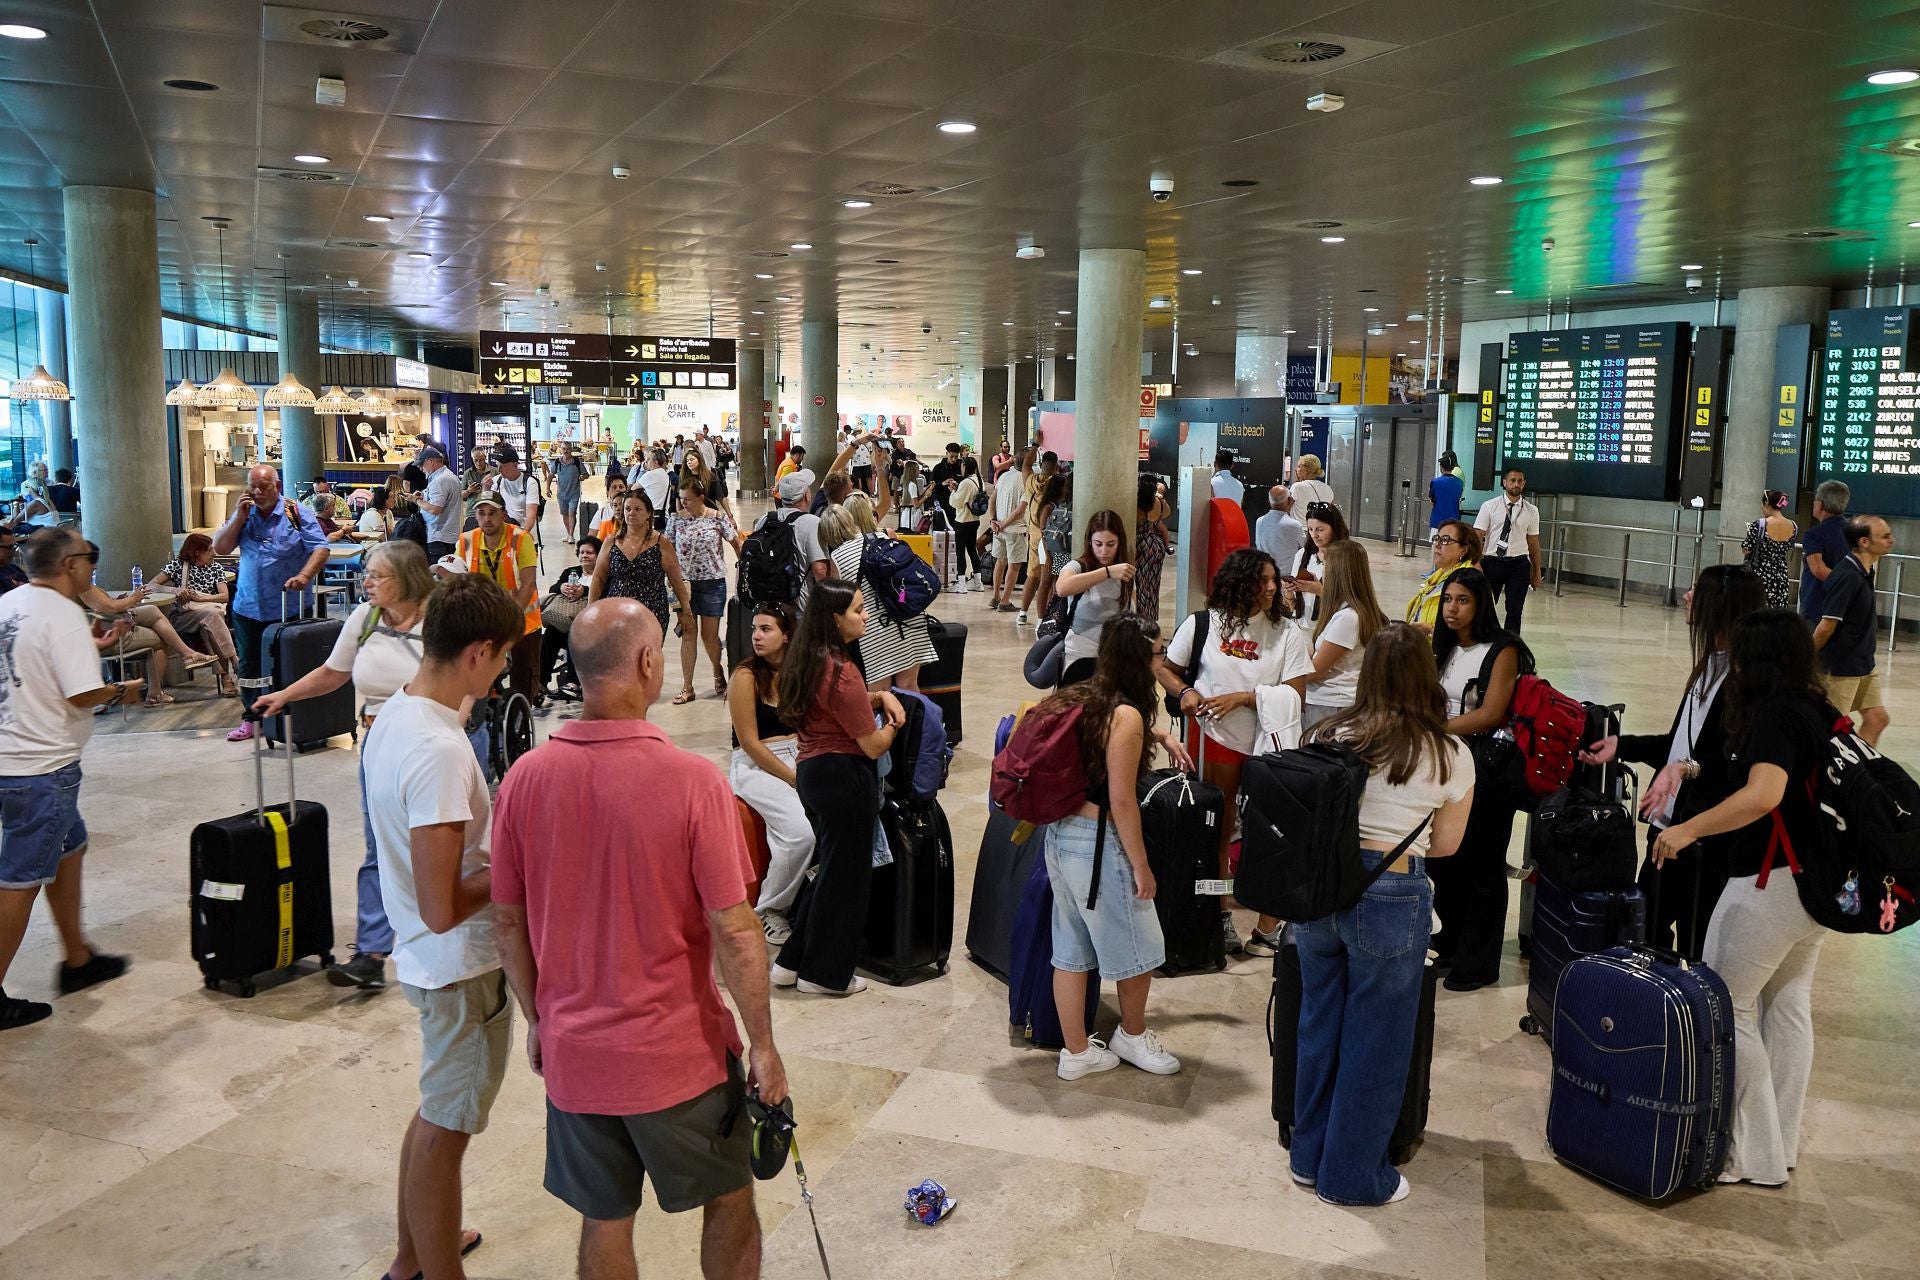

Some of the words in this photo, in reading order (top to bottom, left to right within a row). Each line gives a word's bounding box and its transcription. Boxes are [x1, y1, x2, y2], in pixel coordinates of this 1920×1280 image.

[659, 338, 674, 346] Sala
[659, 352, 674, 361] Sala
[675, 353, 684, 361] de
[684, 353, 711, 362] llegadas
[1829, 349, 1842, 359] FR
[1603, 359, 1625, 367] 13:03
[1627, 357, 1659, 367] ARRIVAL
[1851, 360, 1877, 371] 3103
[543, 369, 573, 377] Departures
[1579, 370, 1600, 379] 12:05
[1626, 368, 1658, 377] ARRIVAL
[544, 376, 568, 384] Salidas
[1826, 373, 1840, 384] FR
[1579, 381, 1600, 390] 12:05
[1626, 379, 1657, 388] ARRIVAL
[1507, 392, 1516, 400] FR
[1539, 391, 1569, 400] TENERIFE
[1578, 390, 1599, 399] 12:25
[1601, 390, 1622, 399] 12:32
[1625, 390, 1656, 399] ARRIVAL
[1825, 387, 1839, 397] FR
[922, 400, 945, 408] EXPO
[1577, 401, 1598, 410] 12:30
[1624, 401, 1655, 410] ARRIVAL
[931, 415, 951, 423] ARTE
[1506, 411, 1515, 420] FR
[1537, 411, 1553, 420] PISA
[1577, 411, 1598, 420] 12:30
[1600, 411, 1621, 420] 13:15
[1623, 411, 1655, 421] DELAYED
[1823, 412, 1836, 422] LX
[1846, 412, 1872, 422] 2142
[1875, 412, 1915, 422] ZURICH
[1220, 422, 1237, 437] Life's
[1237, 426, 1243, 437] a
[1243, 423, 1266, 438] beach
[1576, 422, 1597, 431] 12:40
[1599, 422, 1621, 431] 12:49
[1622, 422, 1654, 431] ARRIVAL
[1822, 424, 1836, 434] FR
[1874, 424, 1913, 435] MALAGA
[1505, 430, 1514, 439] FR
[1575, 432, 1596, 441] 13:25
[1622, 433, 1654, 442] DELAYED
[1536, 441, 1566, 450] TENERIFE
[1574, 442, 1596, 451] 13:25
[1597, 443, 1619, 452] 13:15
[1621, 443, 1632, 452] ON
[1634, 444, 1653, 453] TIME
[1690, 444, 1711, 453] Llegadas
[1771, 447, 1798, 455] Llegadas
[1534, 451, 1569, 460] AMSTERDAM
[1574, 452, 1595, 461] 13:40
[1597, 453, 1618, 462] 13:40
[1620, 454, 1631, 463] ON
[1633, 455, 1652, 464] TIME
[1820, 449, 1834, 459] FR
[1843, 450, 1868, 461] 1714
[1872, 450, 1911, 462] NANTES
[1819, 461, 1833, 472] FR
[1842, 462, 1868, 473] 7373
[1627, 1093, 1697, 1116] AUCKLAND
